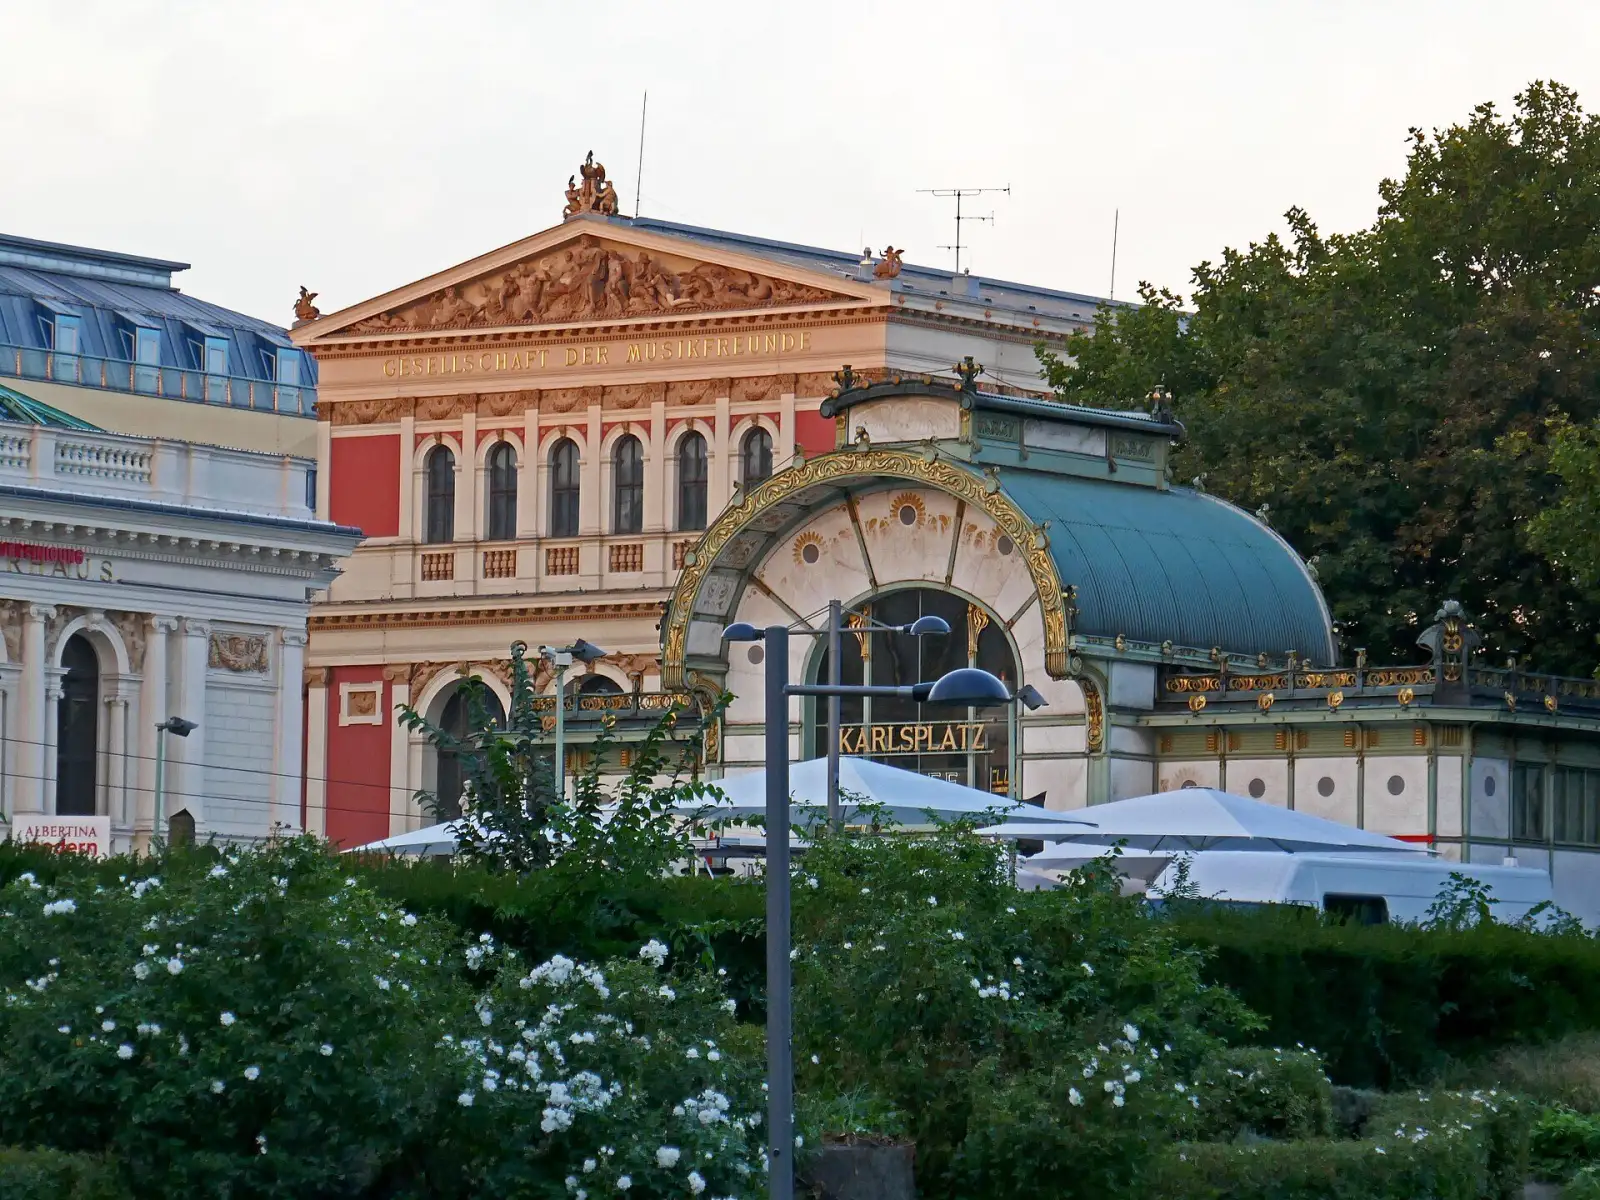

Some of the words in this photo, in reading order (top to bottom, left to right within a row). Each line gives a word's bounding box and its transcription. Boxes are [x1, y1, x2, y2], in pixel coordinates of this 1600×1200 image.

[383, 349, 549, 377] GESELLSCHAFT
[565, 346, 609, 367] DER
[626, 332, 811, 364] MUSIKFREUNDE
[839, 723, 985, 752] KARLSPLATZ
[25, 825, 98, 838] ALBERTINA
